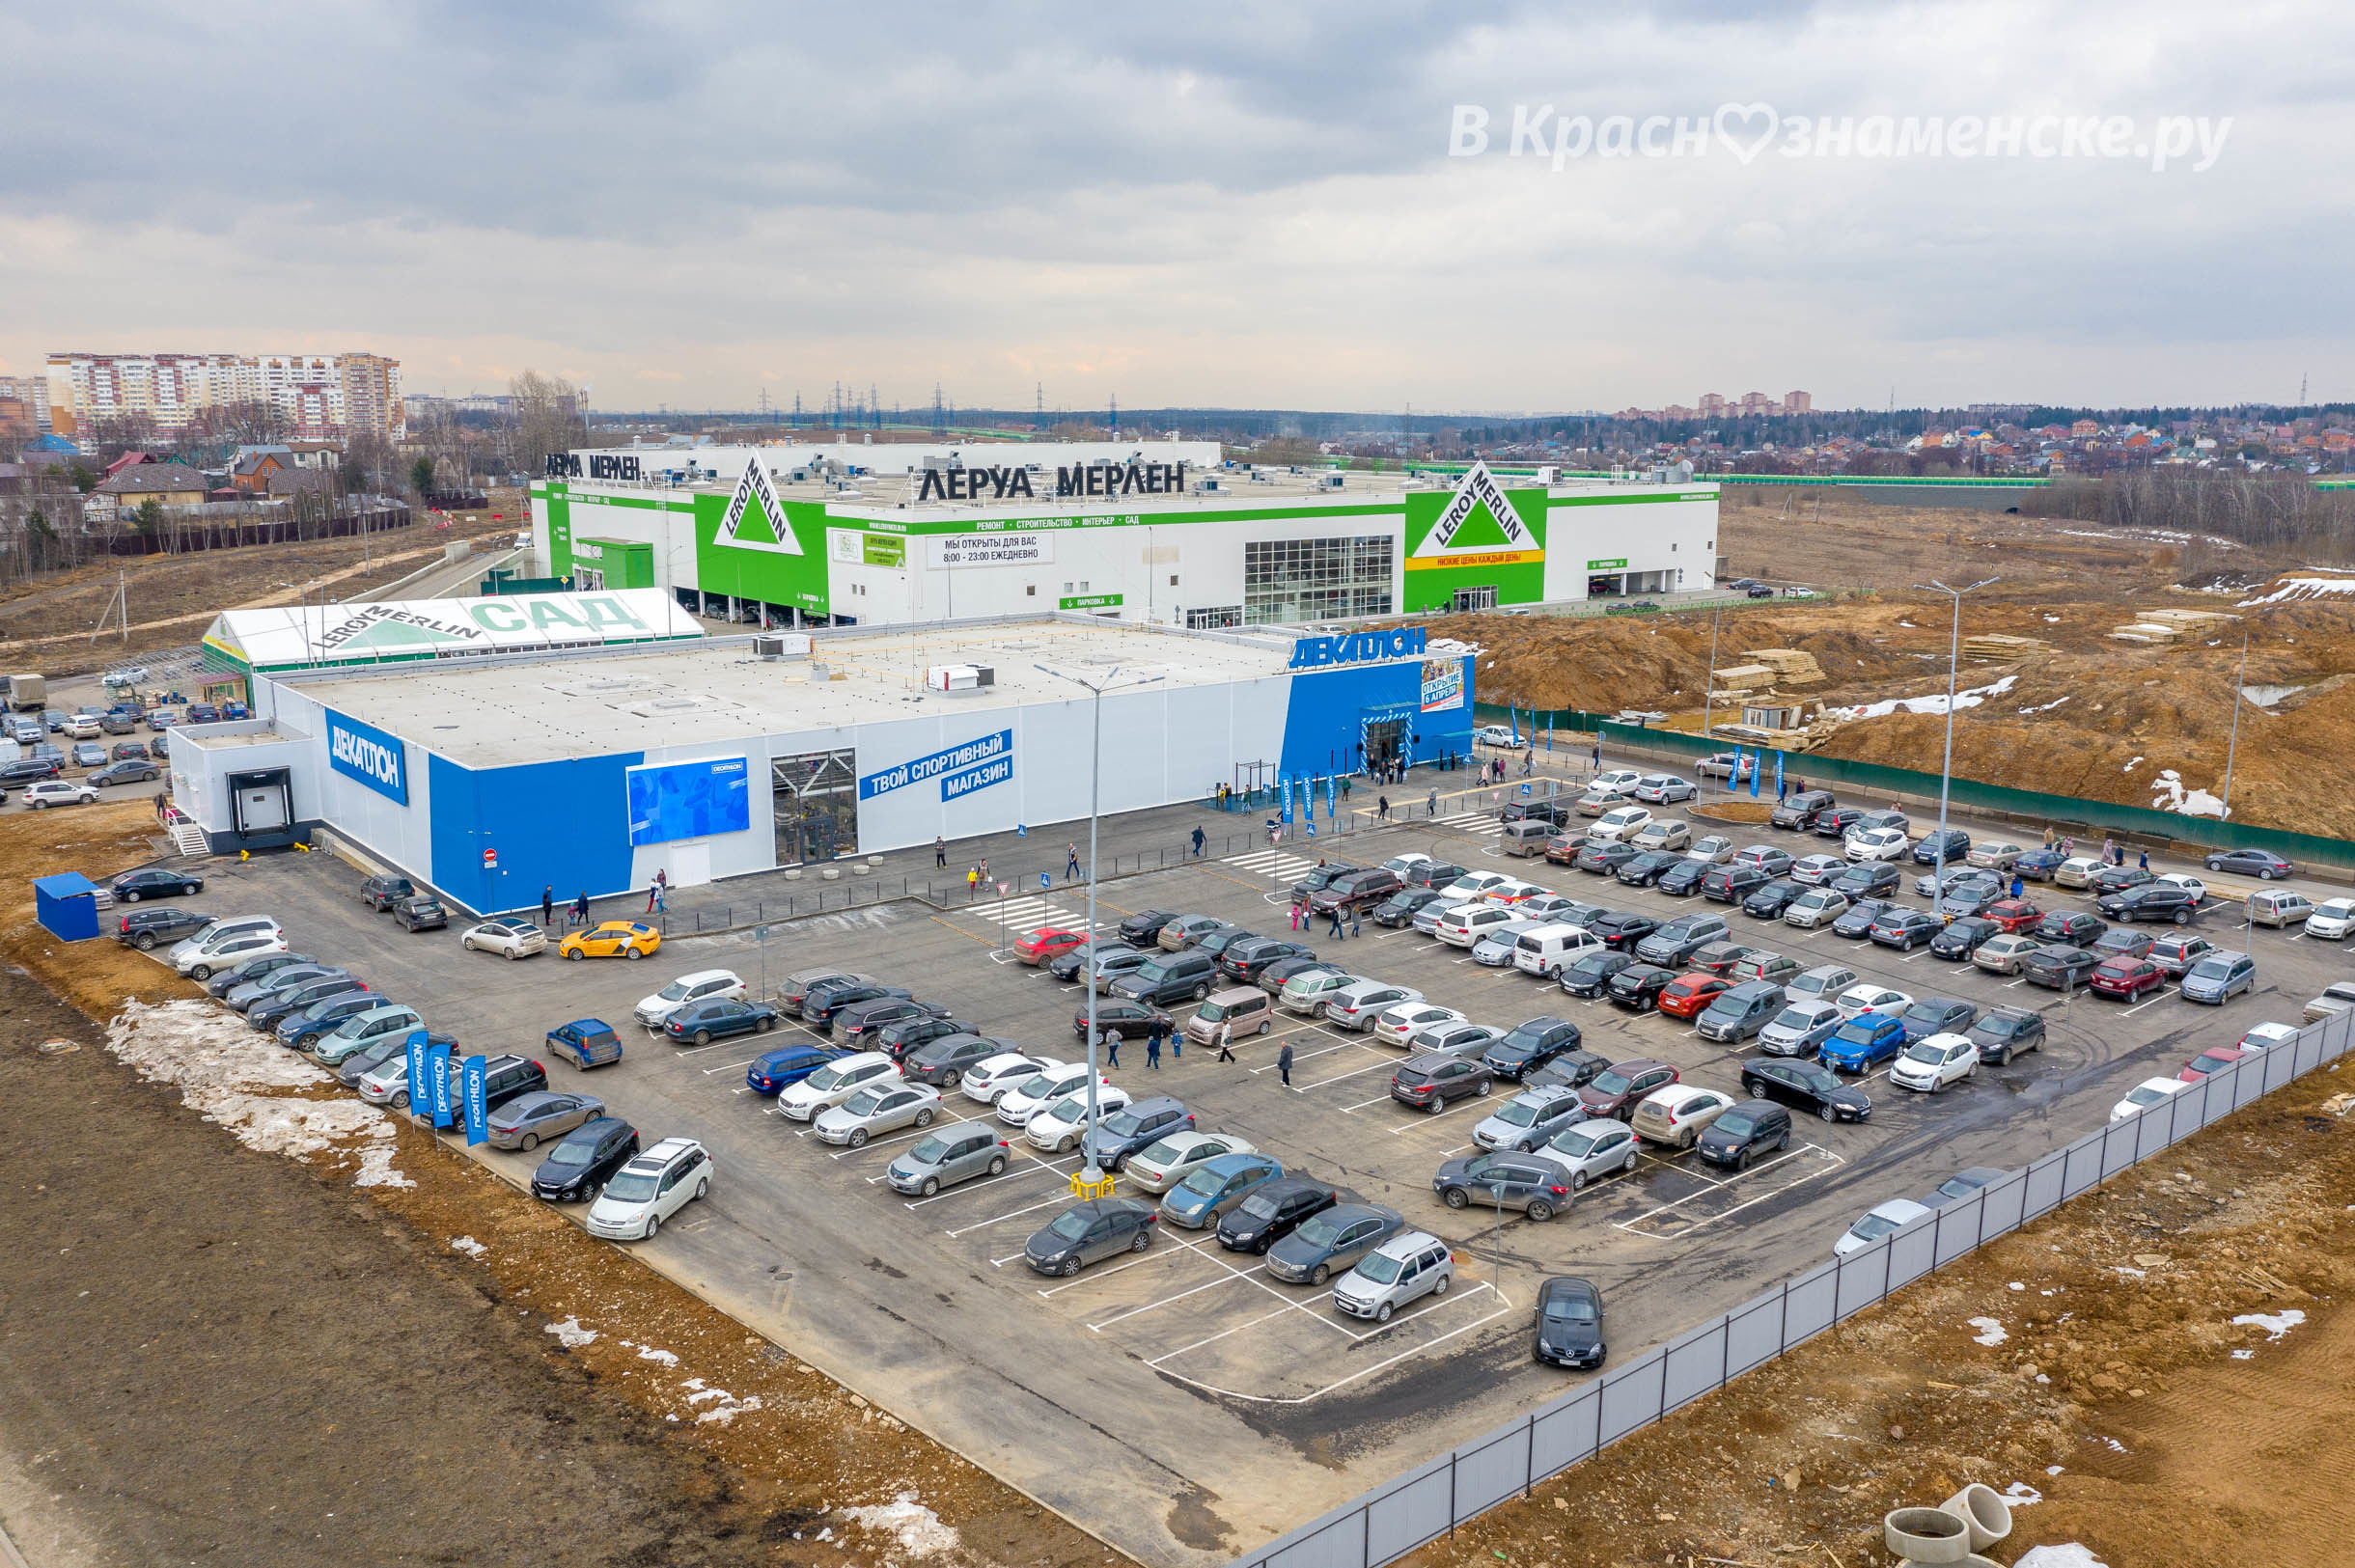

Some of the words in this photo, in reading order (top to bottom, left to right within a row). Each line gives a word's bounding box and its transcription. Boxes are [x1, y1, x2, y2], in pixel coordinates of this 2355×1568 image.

[726, 471, 752, 536] LEROY
[748, 456, 787, 542] MERLIN
[918, 467, 1035, 501] ЛЕРУА
[1057, 463, 1184, 497] МЕРЛЕН
[976, 520, 1006, 531] РЕМОНТ
[1016, 517, 1072, 529] СТРОИТЕЛЬСТВО
[1082, 516, 1115, 526] ИНТЕРЬЕР
[1125, 515, 1140, 525] САД
[1435, 483, 1478, 546] LEROY
[1473, 469, 1522, 542] MERLIN
[943, 552, 960, 563] 8:00
[968, 551, 989, 562] 23:00
[991, 549, 1039, 561] ЕЖЕДНЕВНО
[945, 539, 960, 549] МЫ
[961, 538, 1001, 549] ОТКРЫТЫ
[1003, 536, 1019, 548] ДЛЯ
[1021, 536, 1037, 546] ВАС
[1437, 556, 1460, 566] НИЗКИЕ
[1461, 555, 1478, 564] ЦЕНЫ
[1478, 553, 1505, 564] КАЖДЫЙ
[311, 612, 377, 649] LEROY
[365, 605, 482, 639] MERLIN
[471, 597, 646, 632] САД
[1289, 626, 1426, 669] ДЕКАТЛОН
[1423, 672, 1460, 694] ОТКРЫТИЕ
[1425, 694, 1430, 703] 6
[1430, 684, 1455, 701] АПРЕЛЯ
[332, 725, 399, 787] ДЕКАТЛОН
[713, 762, 741, 772] DECATHLON
[872, 764, 909, 794] ТВОЙ
[911, 733, 1003, 781] СПОРТИВНЫЙ
[947, 760, 1009, 796] МАГАЗИН
[413, 1043, 428, 1099] DECATHLON
[433, 1057, 448, 1113] DECATHLON
